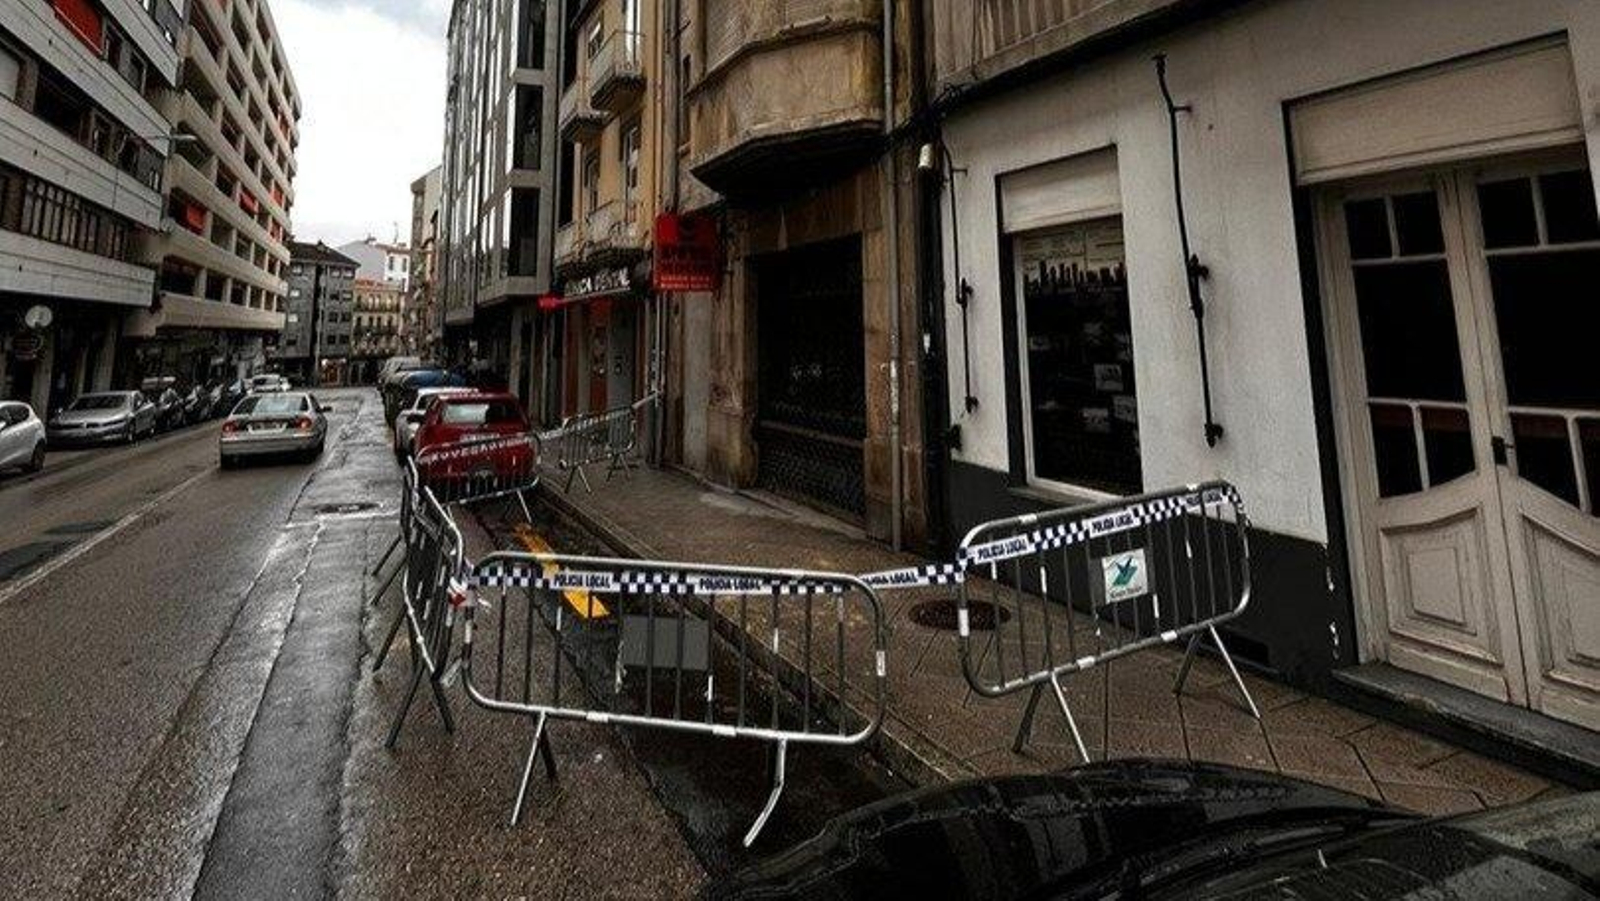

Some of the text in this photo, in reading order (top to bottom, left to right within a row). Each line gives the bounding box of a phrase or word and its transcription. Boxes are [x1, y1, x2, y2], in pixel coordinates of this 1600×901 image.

[977, 538, 1027, 560] POLICIA LOCAL
[554, 573, 611, 589] POLICIA LOCAL
[700, 577, 761, 591] POLICIA LOCAL
[890, 570, 919, 584] LOCAL
